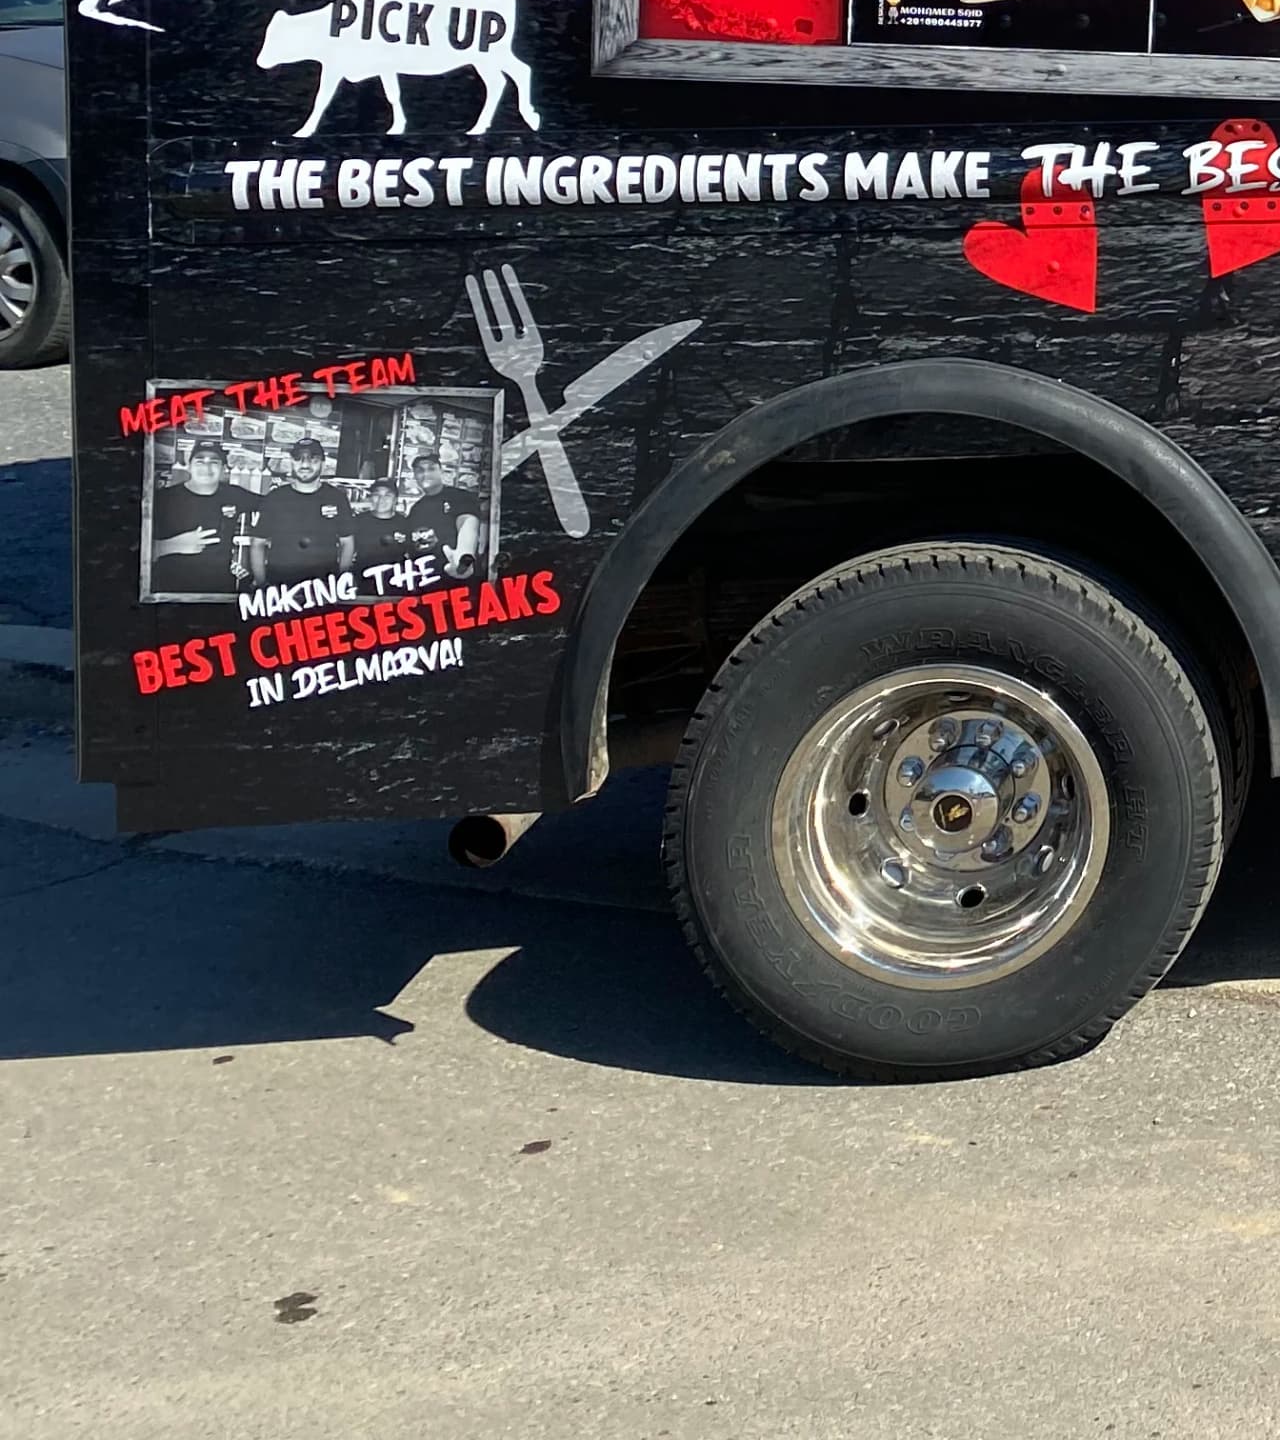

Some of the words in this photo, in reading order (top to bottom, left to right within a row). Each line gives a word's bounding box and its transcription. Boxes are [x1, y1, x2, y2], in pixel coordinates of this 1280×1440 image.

[449, 5, 506, 53] UP
[224, 160, 325, 211] THE
[338, 158, 473, 209] BEST
[486, 153, 829, 207] INGREDIENTS
[845, 150, 990, 200] MAKE
[1021, 141, 1160, 198] THE
[119, 391, 215, 437] MEAT
[226, 372, 310, 417] THE
[316, 353, 415, 403] TEAM
[237, 569, 357, 620] MAKING
[363, 554, 440, 600] THE
[133, 632, 236, 696] BEST
[249, 570, 561, 669] CHEESESTEAKS
[246, 676, 288, 708] IN
[291, 637, 463, 698] DELMARVA!
